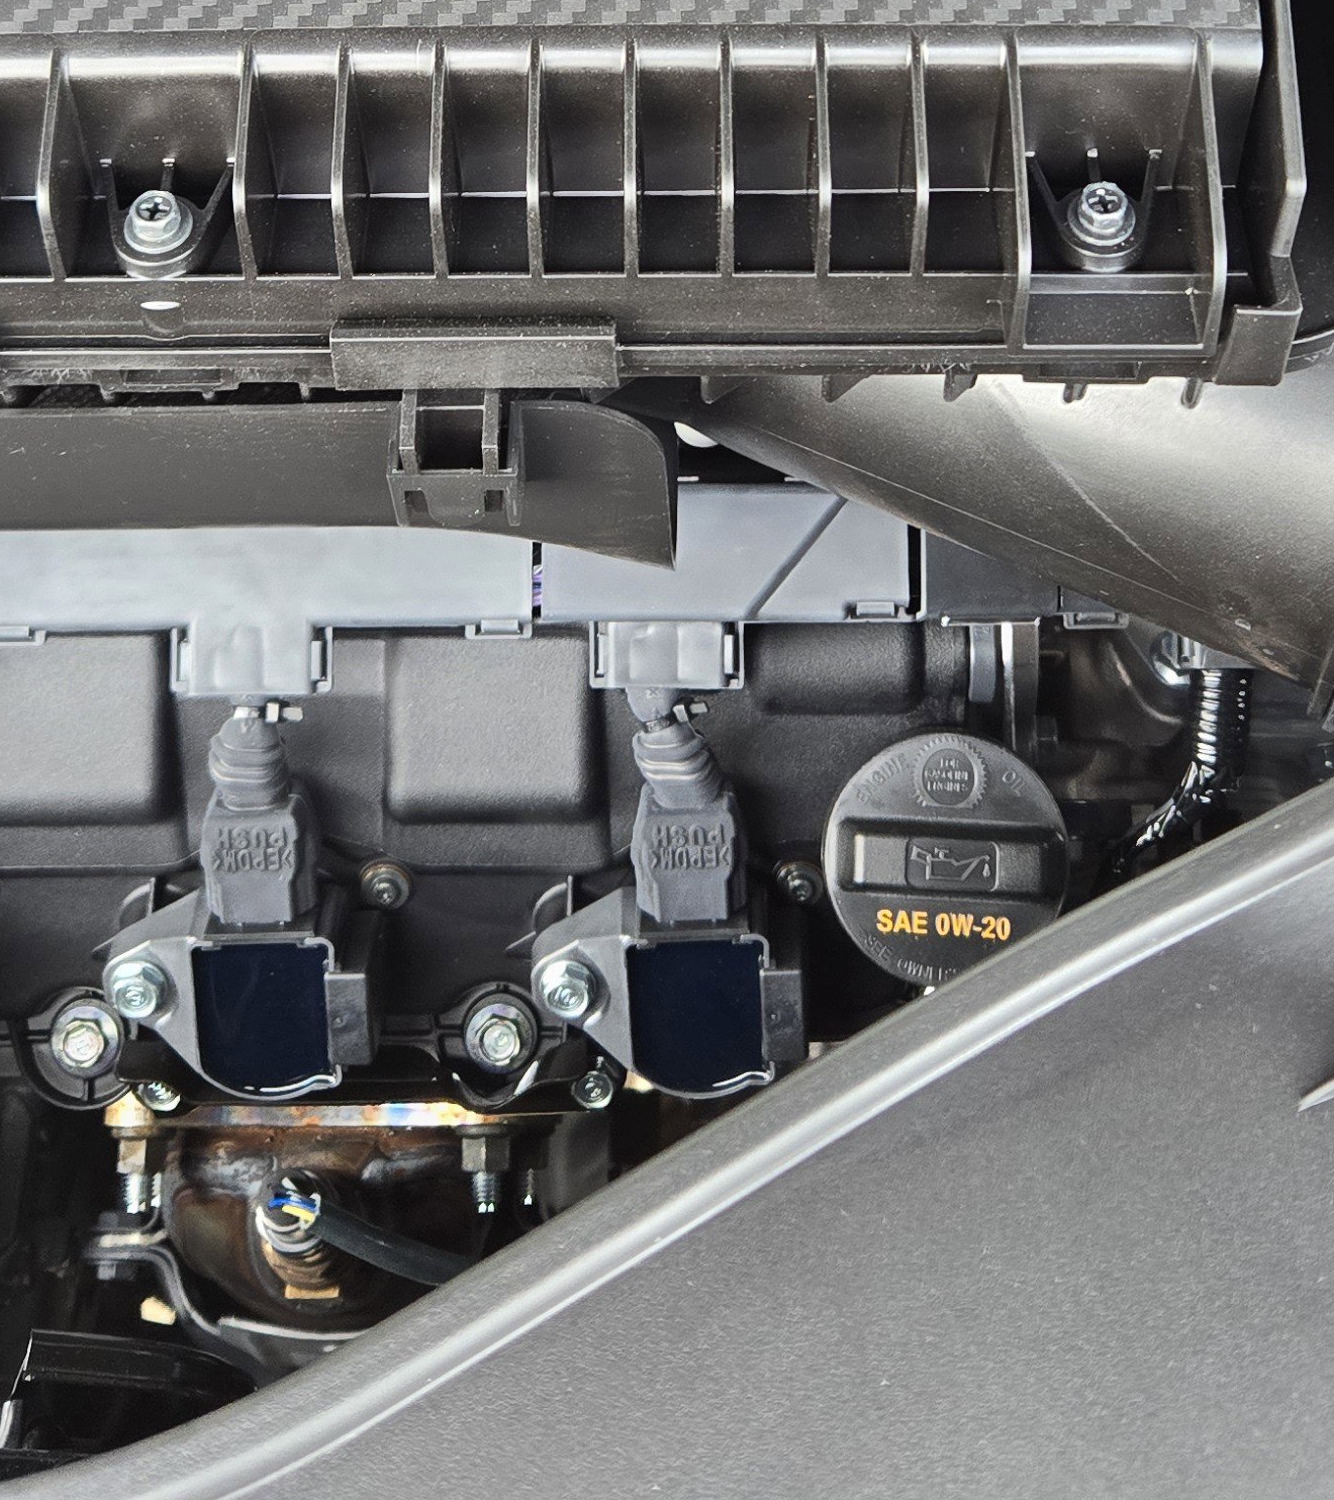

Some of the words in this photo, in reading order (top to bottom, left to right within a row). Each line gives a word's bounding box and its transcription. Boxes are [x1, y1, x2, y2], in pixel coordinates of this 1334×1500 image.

[1001, 768, 1027, 797] OIL
[214, 825, 288, 850] PUSH
[652, 823, 725, 848] PUSH
[875, 908, 929, 935] SAE
[934, 912, 1012, 942] 0W-20
